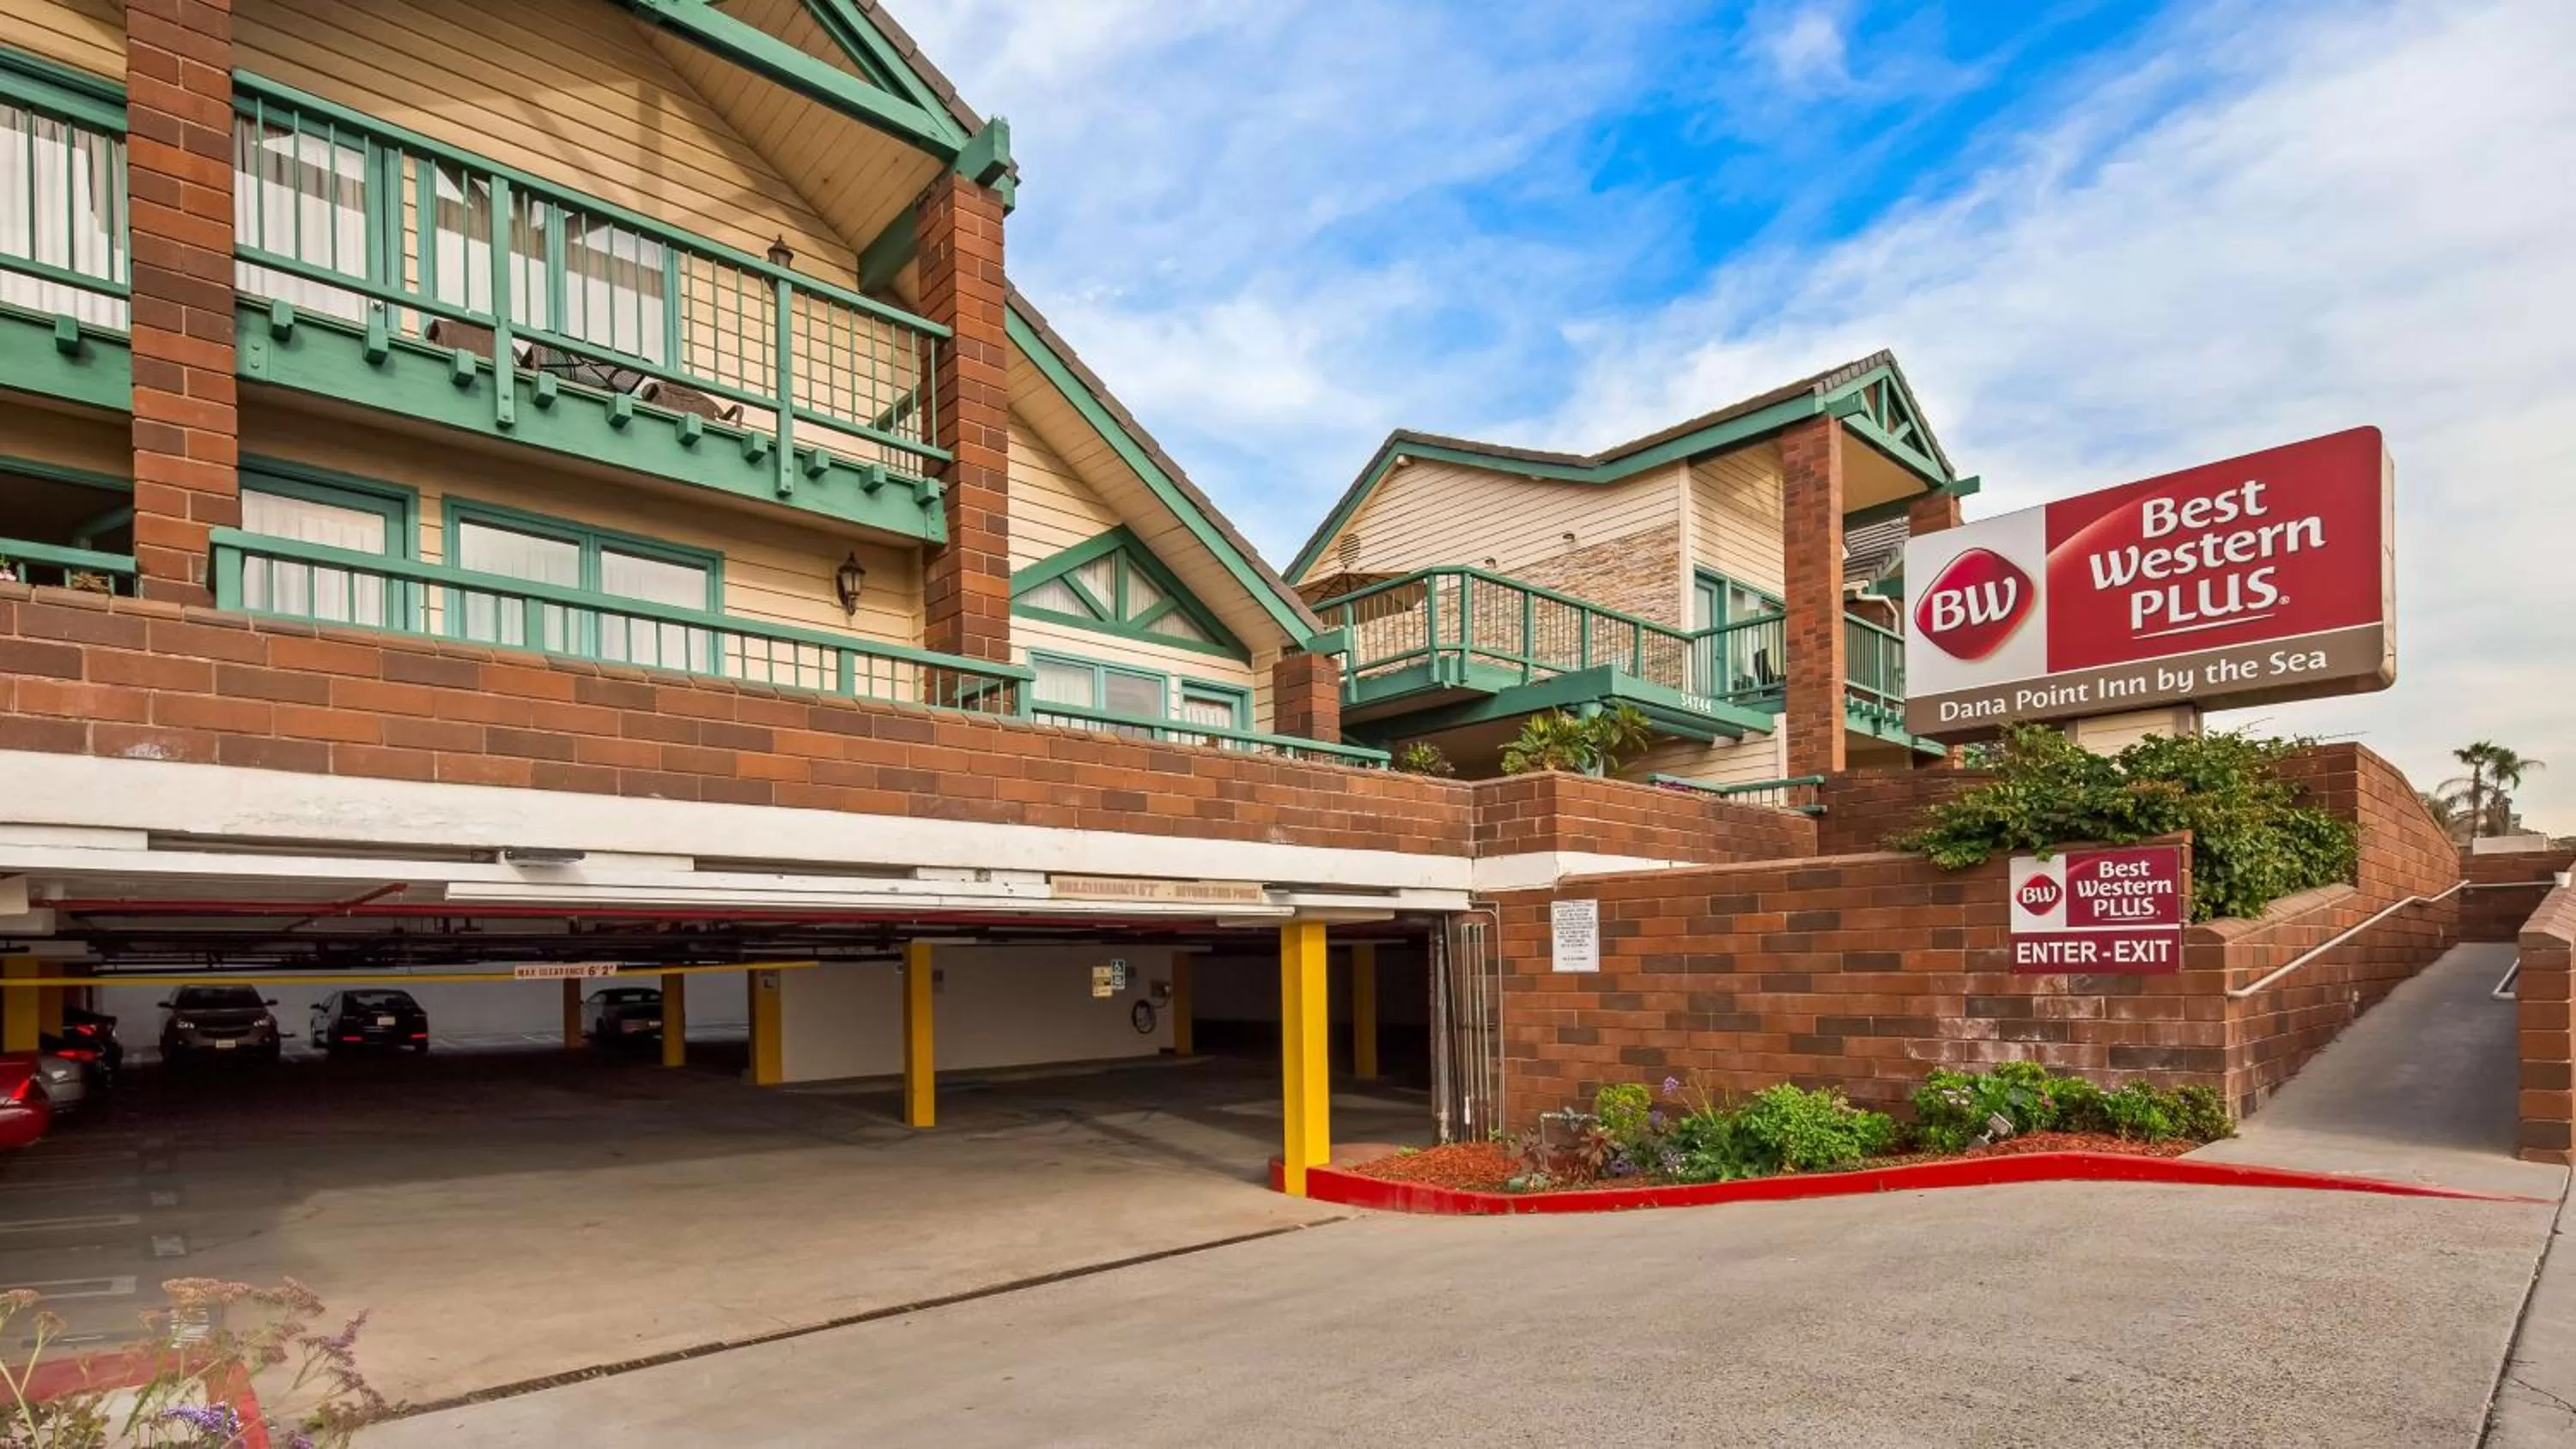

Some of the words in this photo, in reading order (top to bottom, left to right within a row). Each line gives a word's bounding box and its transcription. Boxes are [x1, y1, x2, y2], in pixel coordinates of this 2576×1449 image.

[2142, 480, 2268, 539] Best
[2089, 516, 2326, 591] Western
[1931, 575, 2018, 633] BW
[1940, 696, 2007, 723] Dana
[2015, 683, 2089, 712] Point
[2099, 674, 2147, 700] Inn
[2157, 666, 2195, 694] by
[2205, 653, 2259, 684] the
[2269, 648, 2328, 676] Sea
[2022, 886, 2057, 904] BW
[2076, 879, 2173, 898] Western
[2099, 860, 2151, 879] Best
